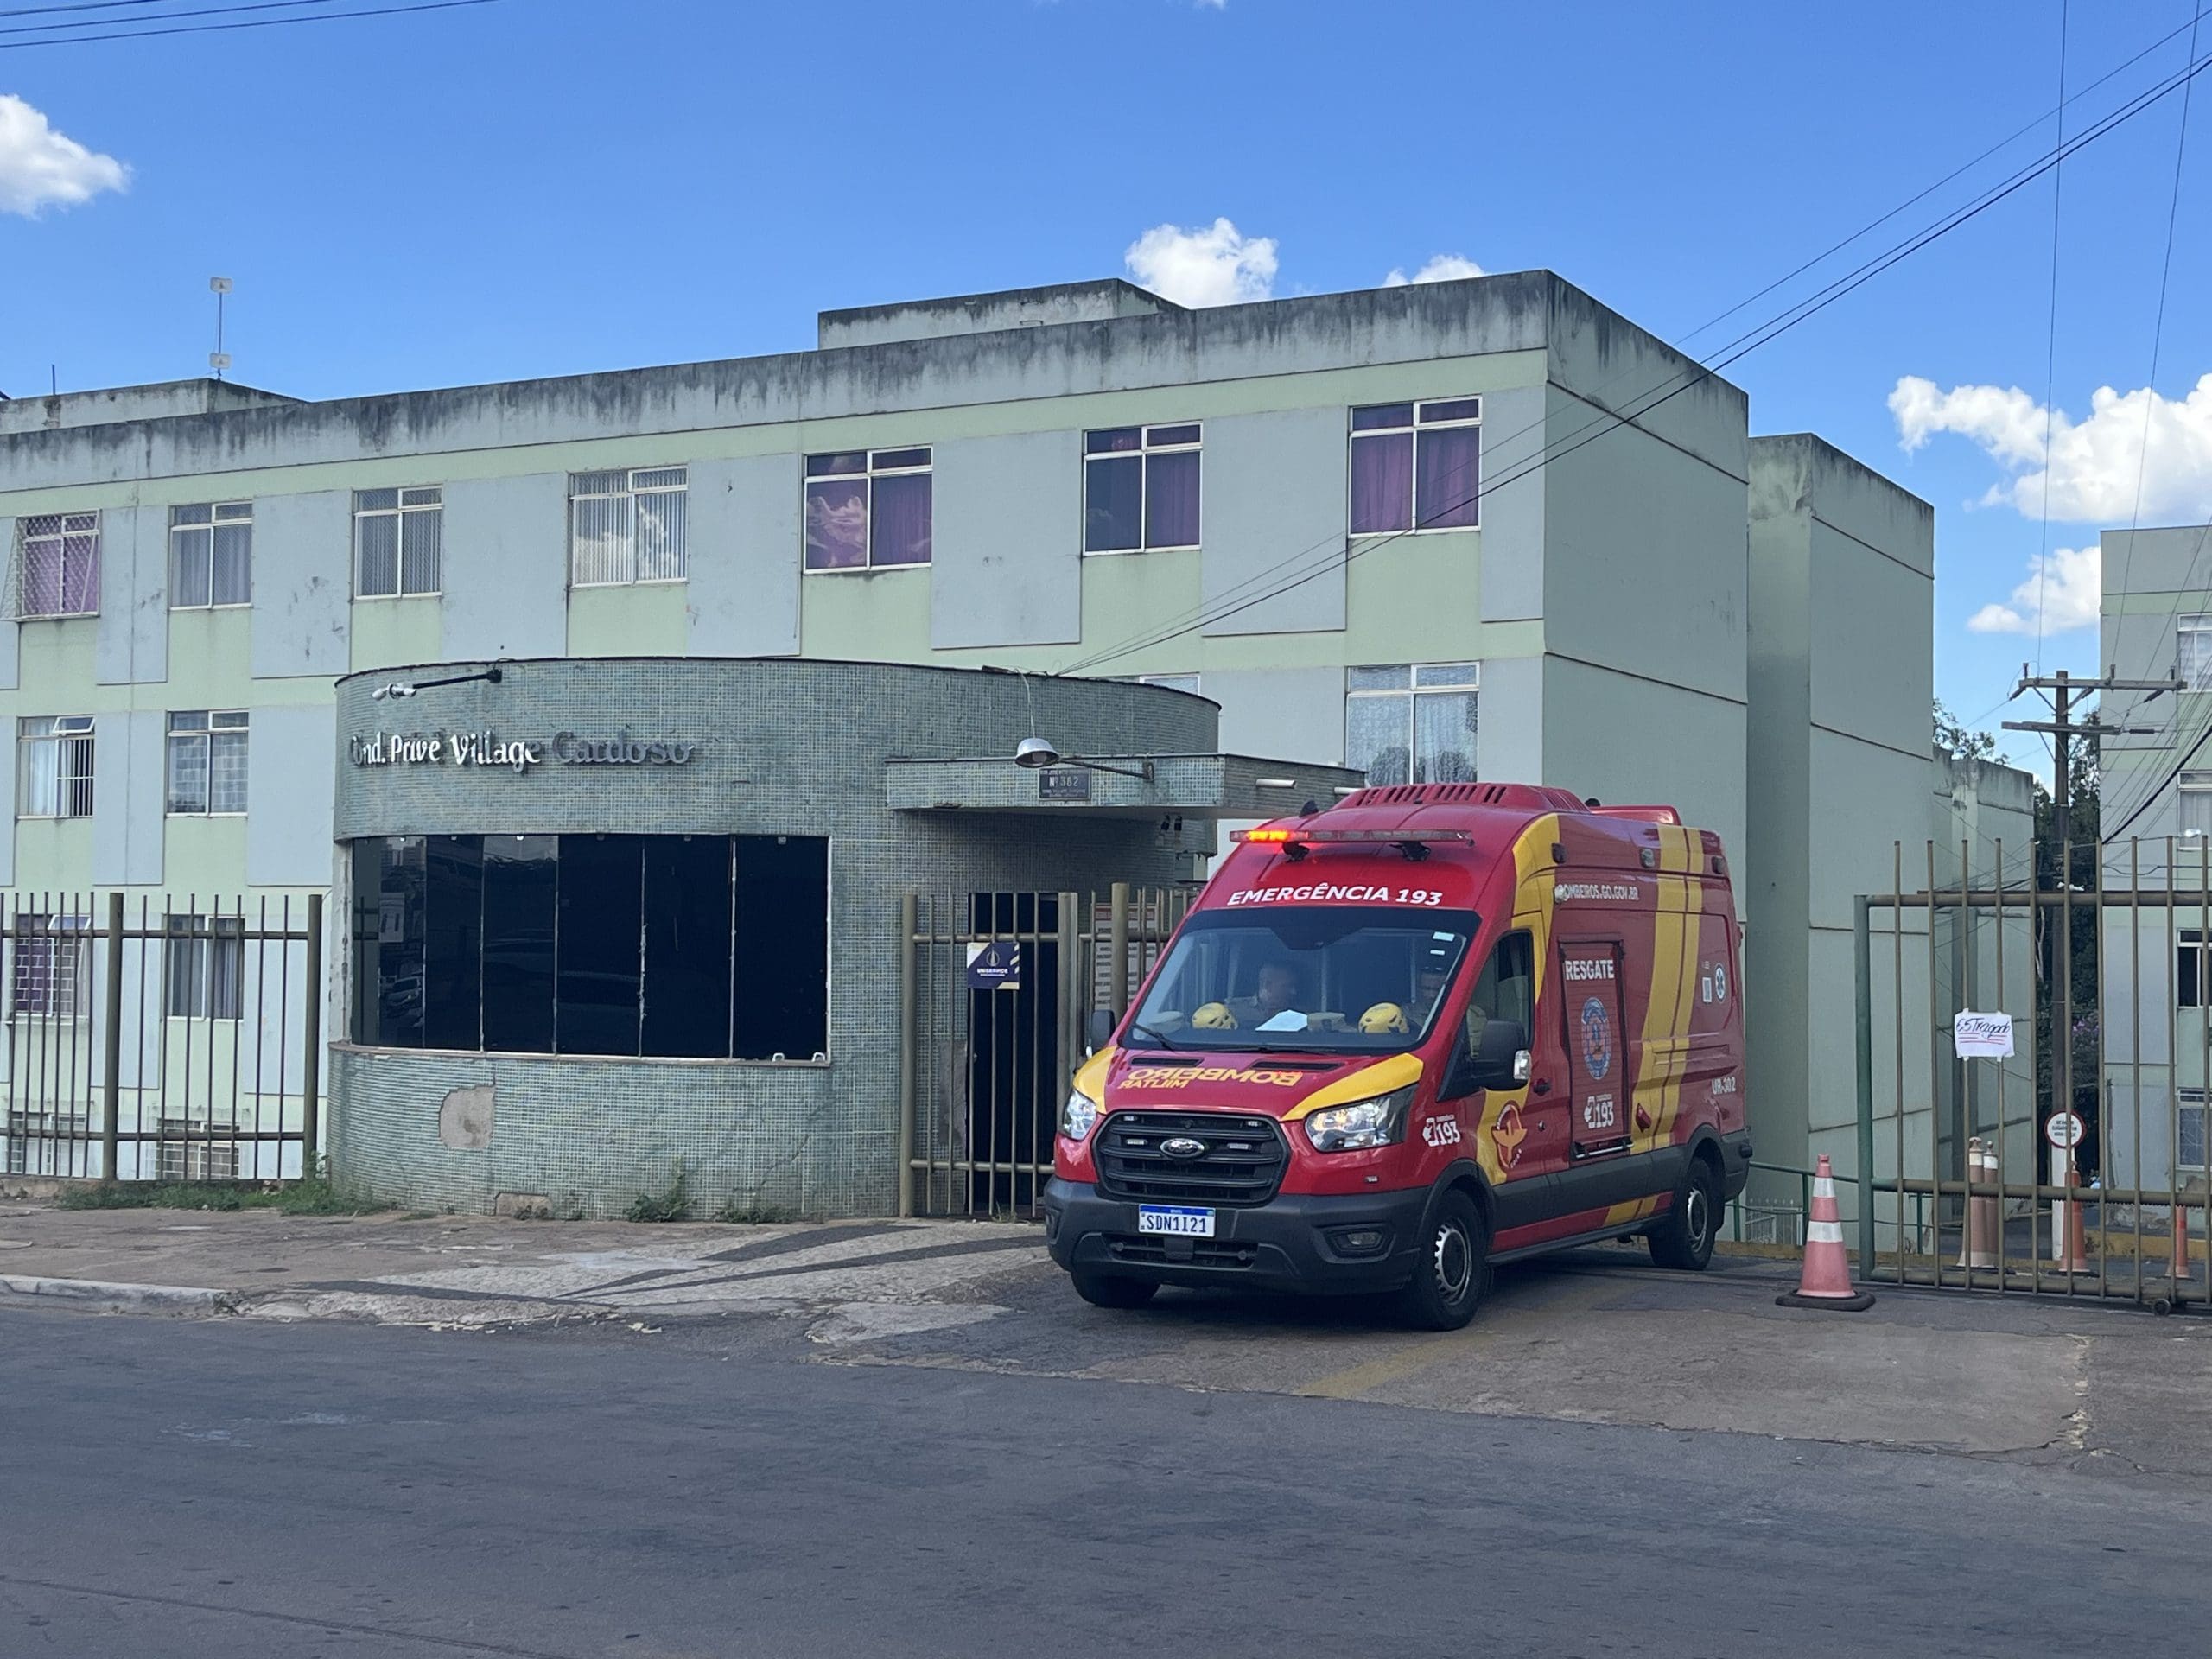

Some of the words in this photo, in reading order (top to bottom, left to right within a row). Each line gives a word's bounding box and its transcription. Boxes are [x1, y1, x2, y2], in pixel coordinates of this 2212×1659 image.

[449, 730, 542, 773] Village
[552, 729, 695, 764] Cardoso
[1227, 883, 1389, 906] EMERGÊNCIA
[1395, 889, 1442, 906] 193
[1565, 960, 1615, 981] RESGATE
[1596, 1101, 1614, 1128] 193
[1436, 1121, 1460, 1145] 193
[1147, 1215, 1206, 1233] SDN1I21
